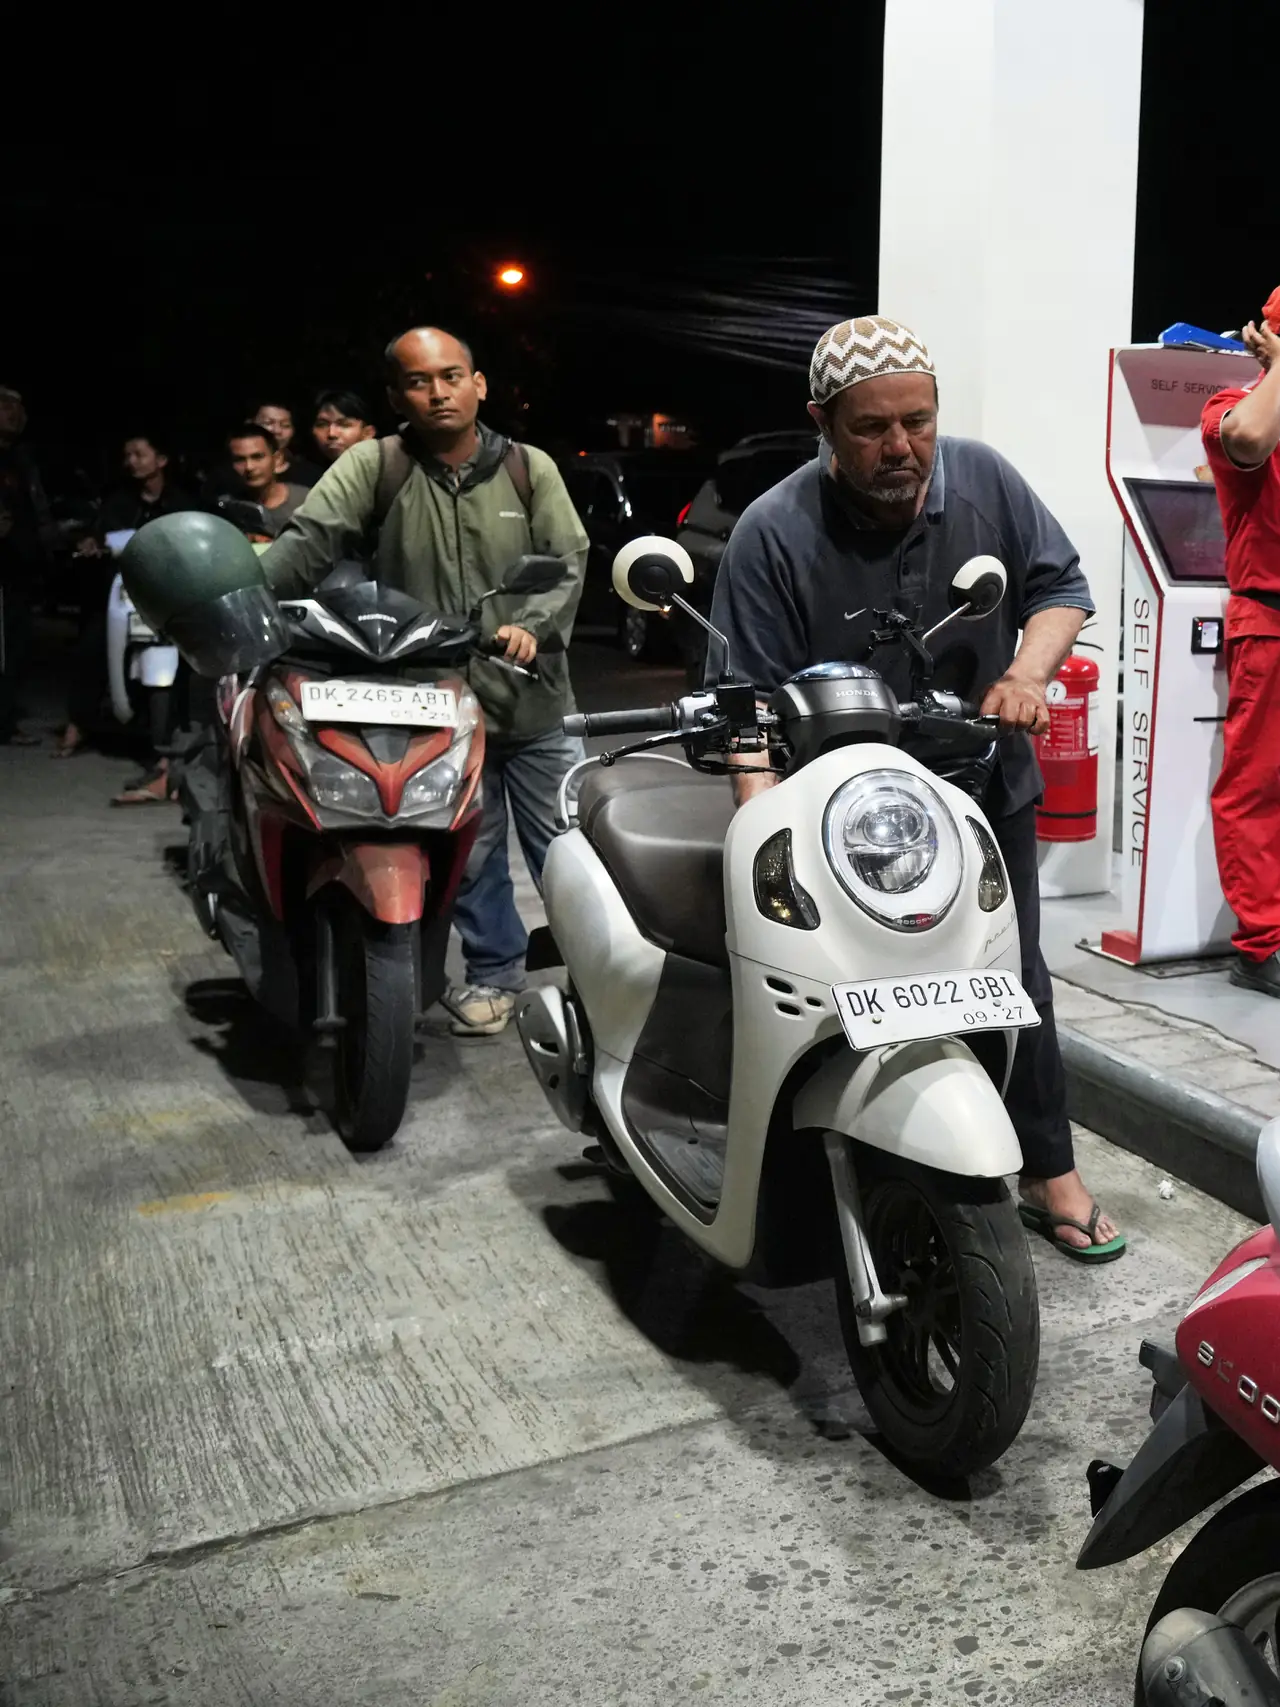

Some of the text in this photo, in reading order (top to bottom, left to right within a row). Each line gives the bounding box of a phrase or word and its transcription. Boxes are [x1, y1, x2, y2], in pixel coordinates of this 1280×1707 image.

[1151, 379, 1178, 392] SELF
[309, 686, 450, 706] DK 2465 ABT
[836, 689, 879, 698] HONDA
[1052, 688, 1058, 697] 7
[1131, 597, 1150, 867] SELF SERVICE
[846, 976, 1016, 1017] DK 6022 GBI
